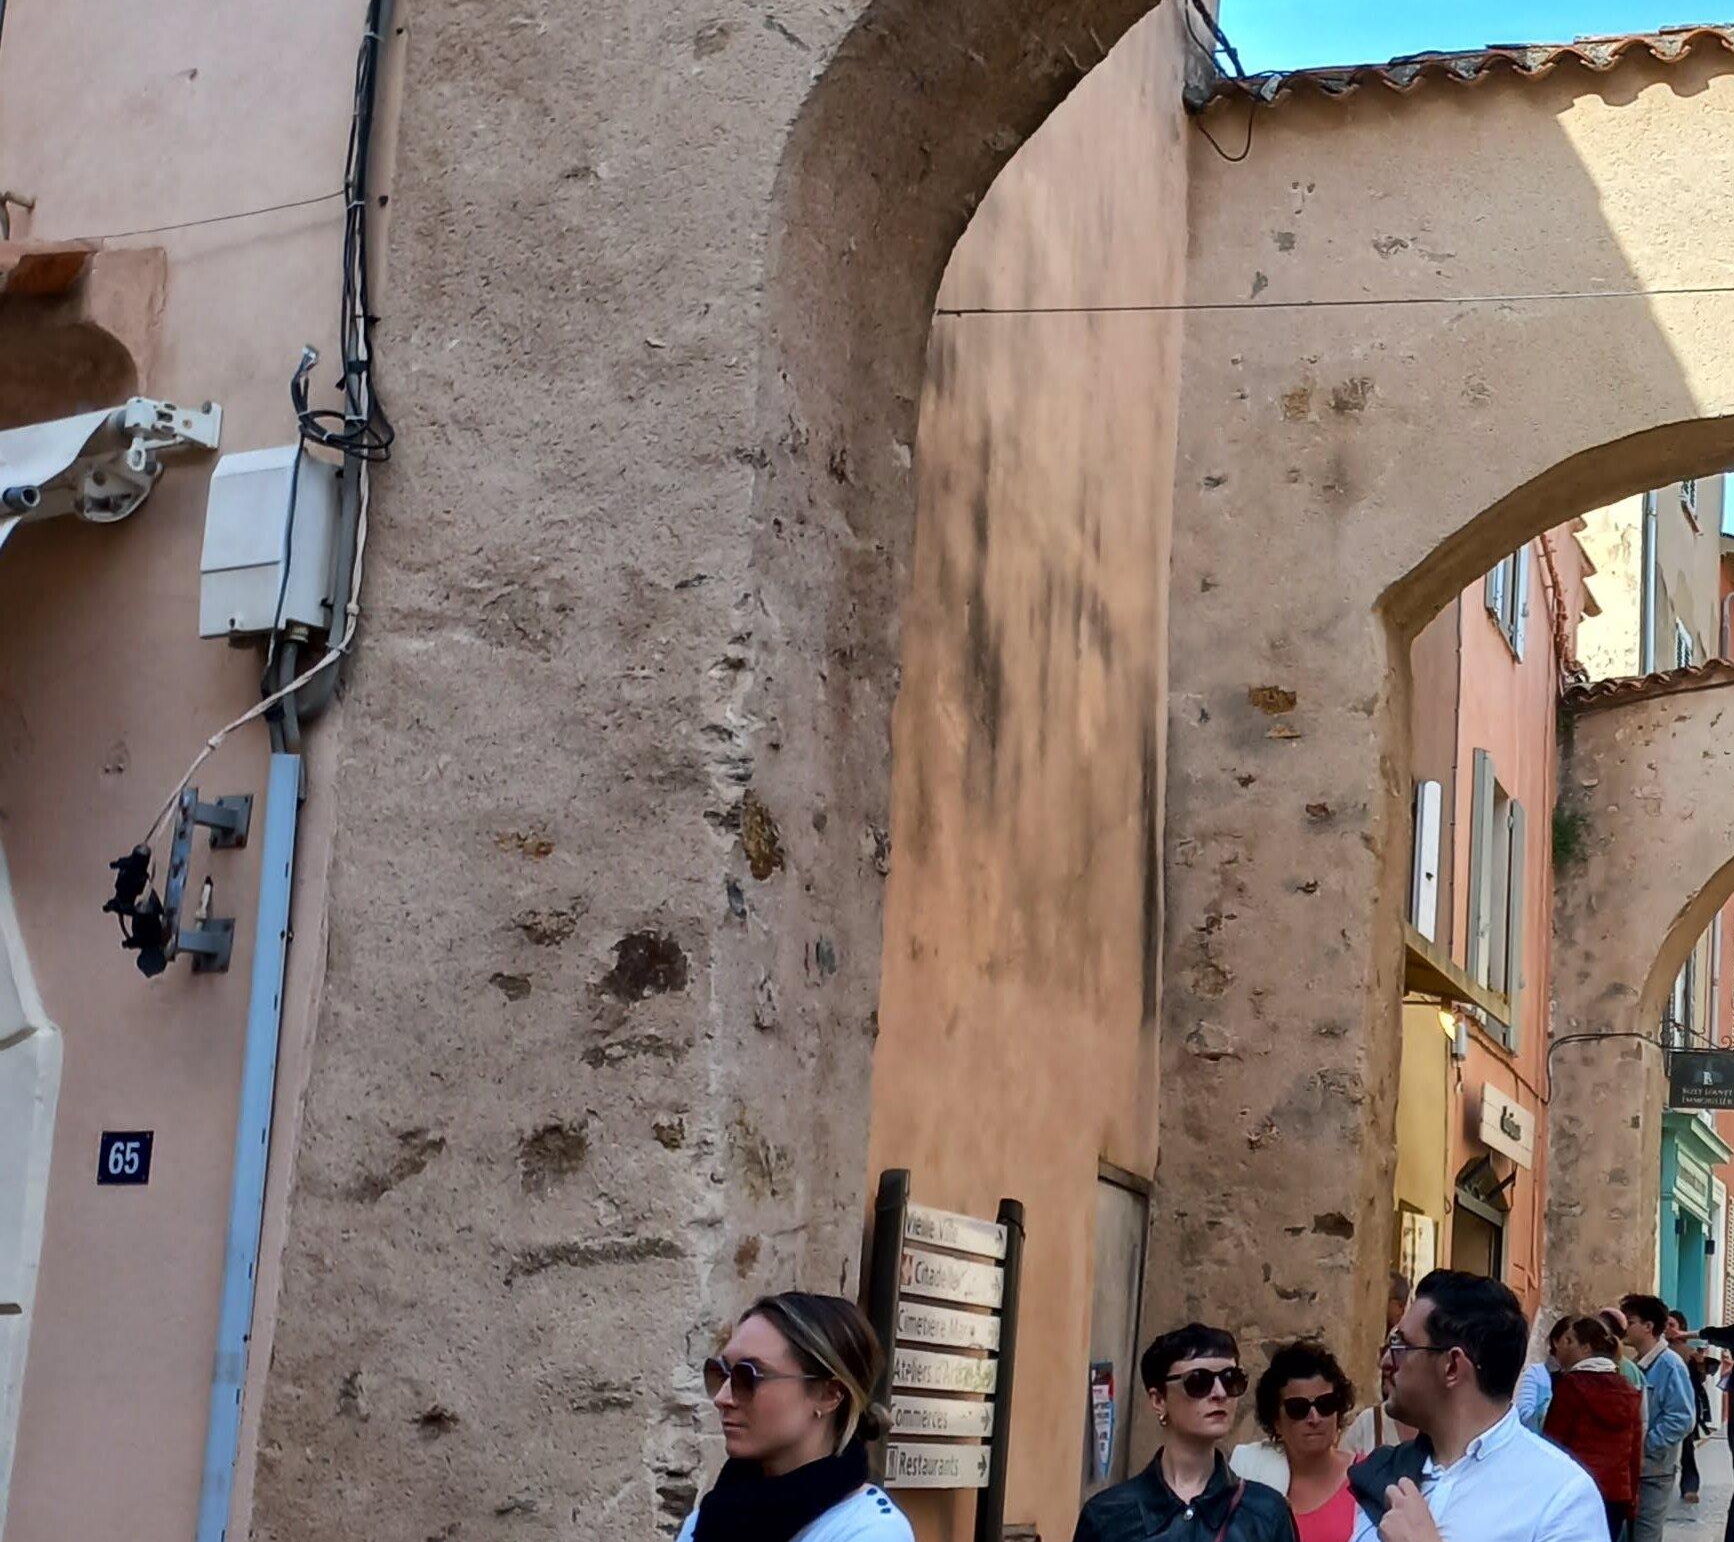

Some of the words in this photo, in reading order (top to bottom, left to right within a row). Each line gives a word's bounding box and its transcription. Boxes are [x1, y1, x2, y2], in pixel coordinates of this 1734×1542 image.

[107, 1140, 142, 1175] 65
[891, 1403, 949, 1430] Commerces
[898, 1451, 960, 1477] Restaurants
